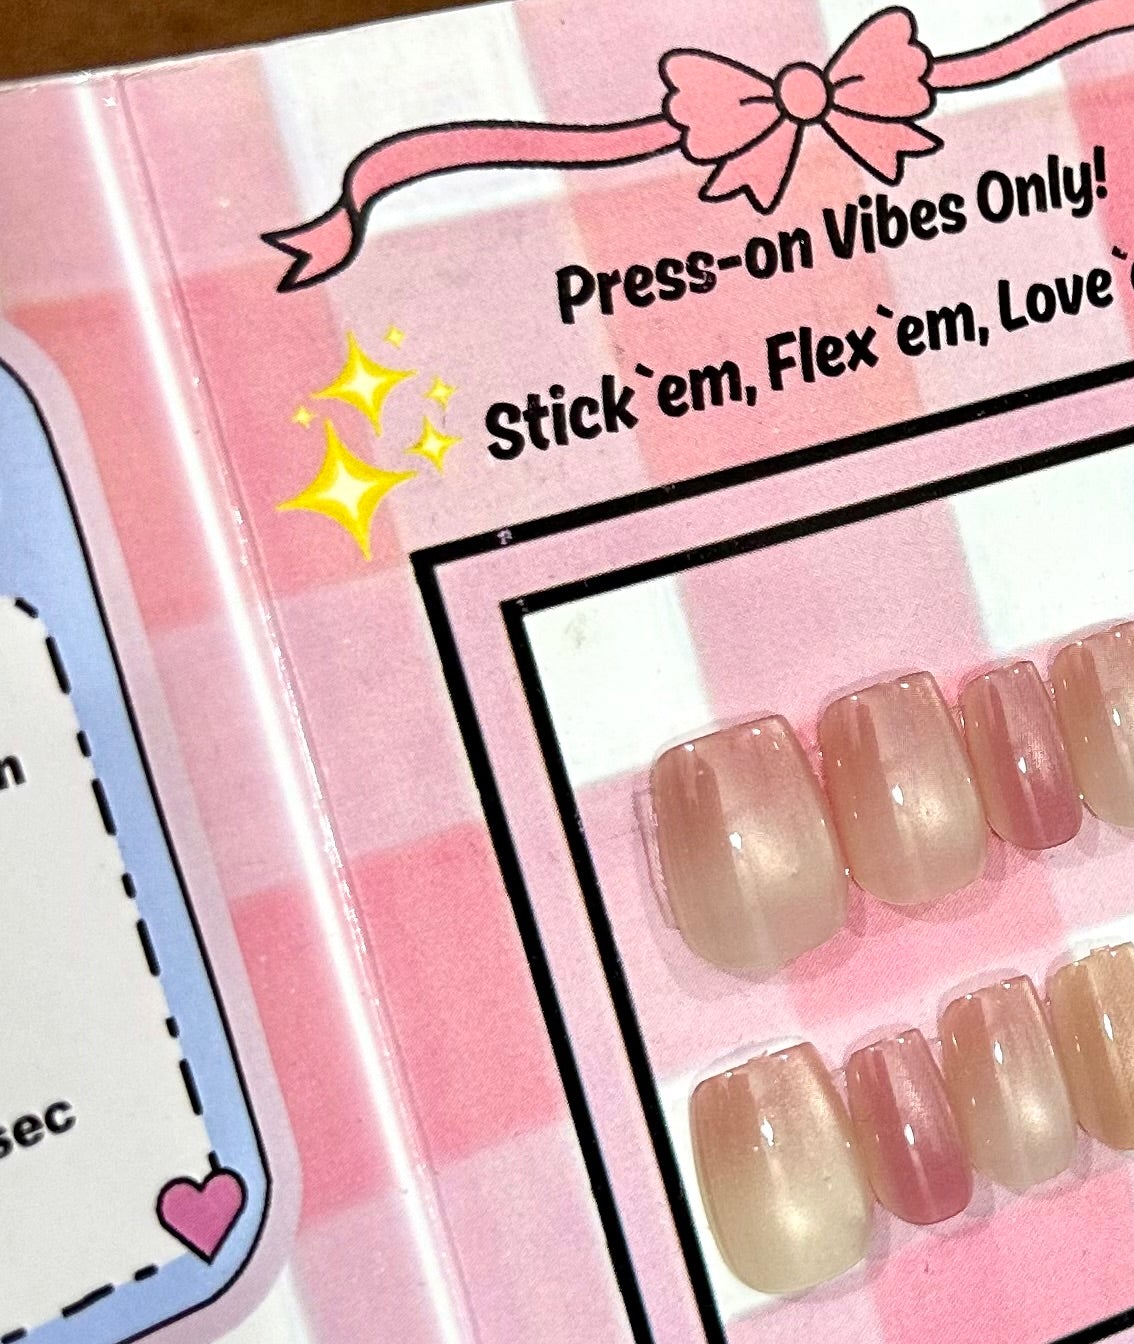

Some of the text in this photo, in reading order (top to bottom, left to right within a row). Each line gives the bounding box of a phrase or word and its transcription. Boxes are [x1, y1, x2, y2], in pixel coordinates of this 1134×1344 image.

[554, 144, 1109, 326] Press-on Vibes Only!
